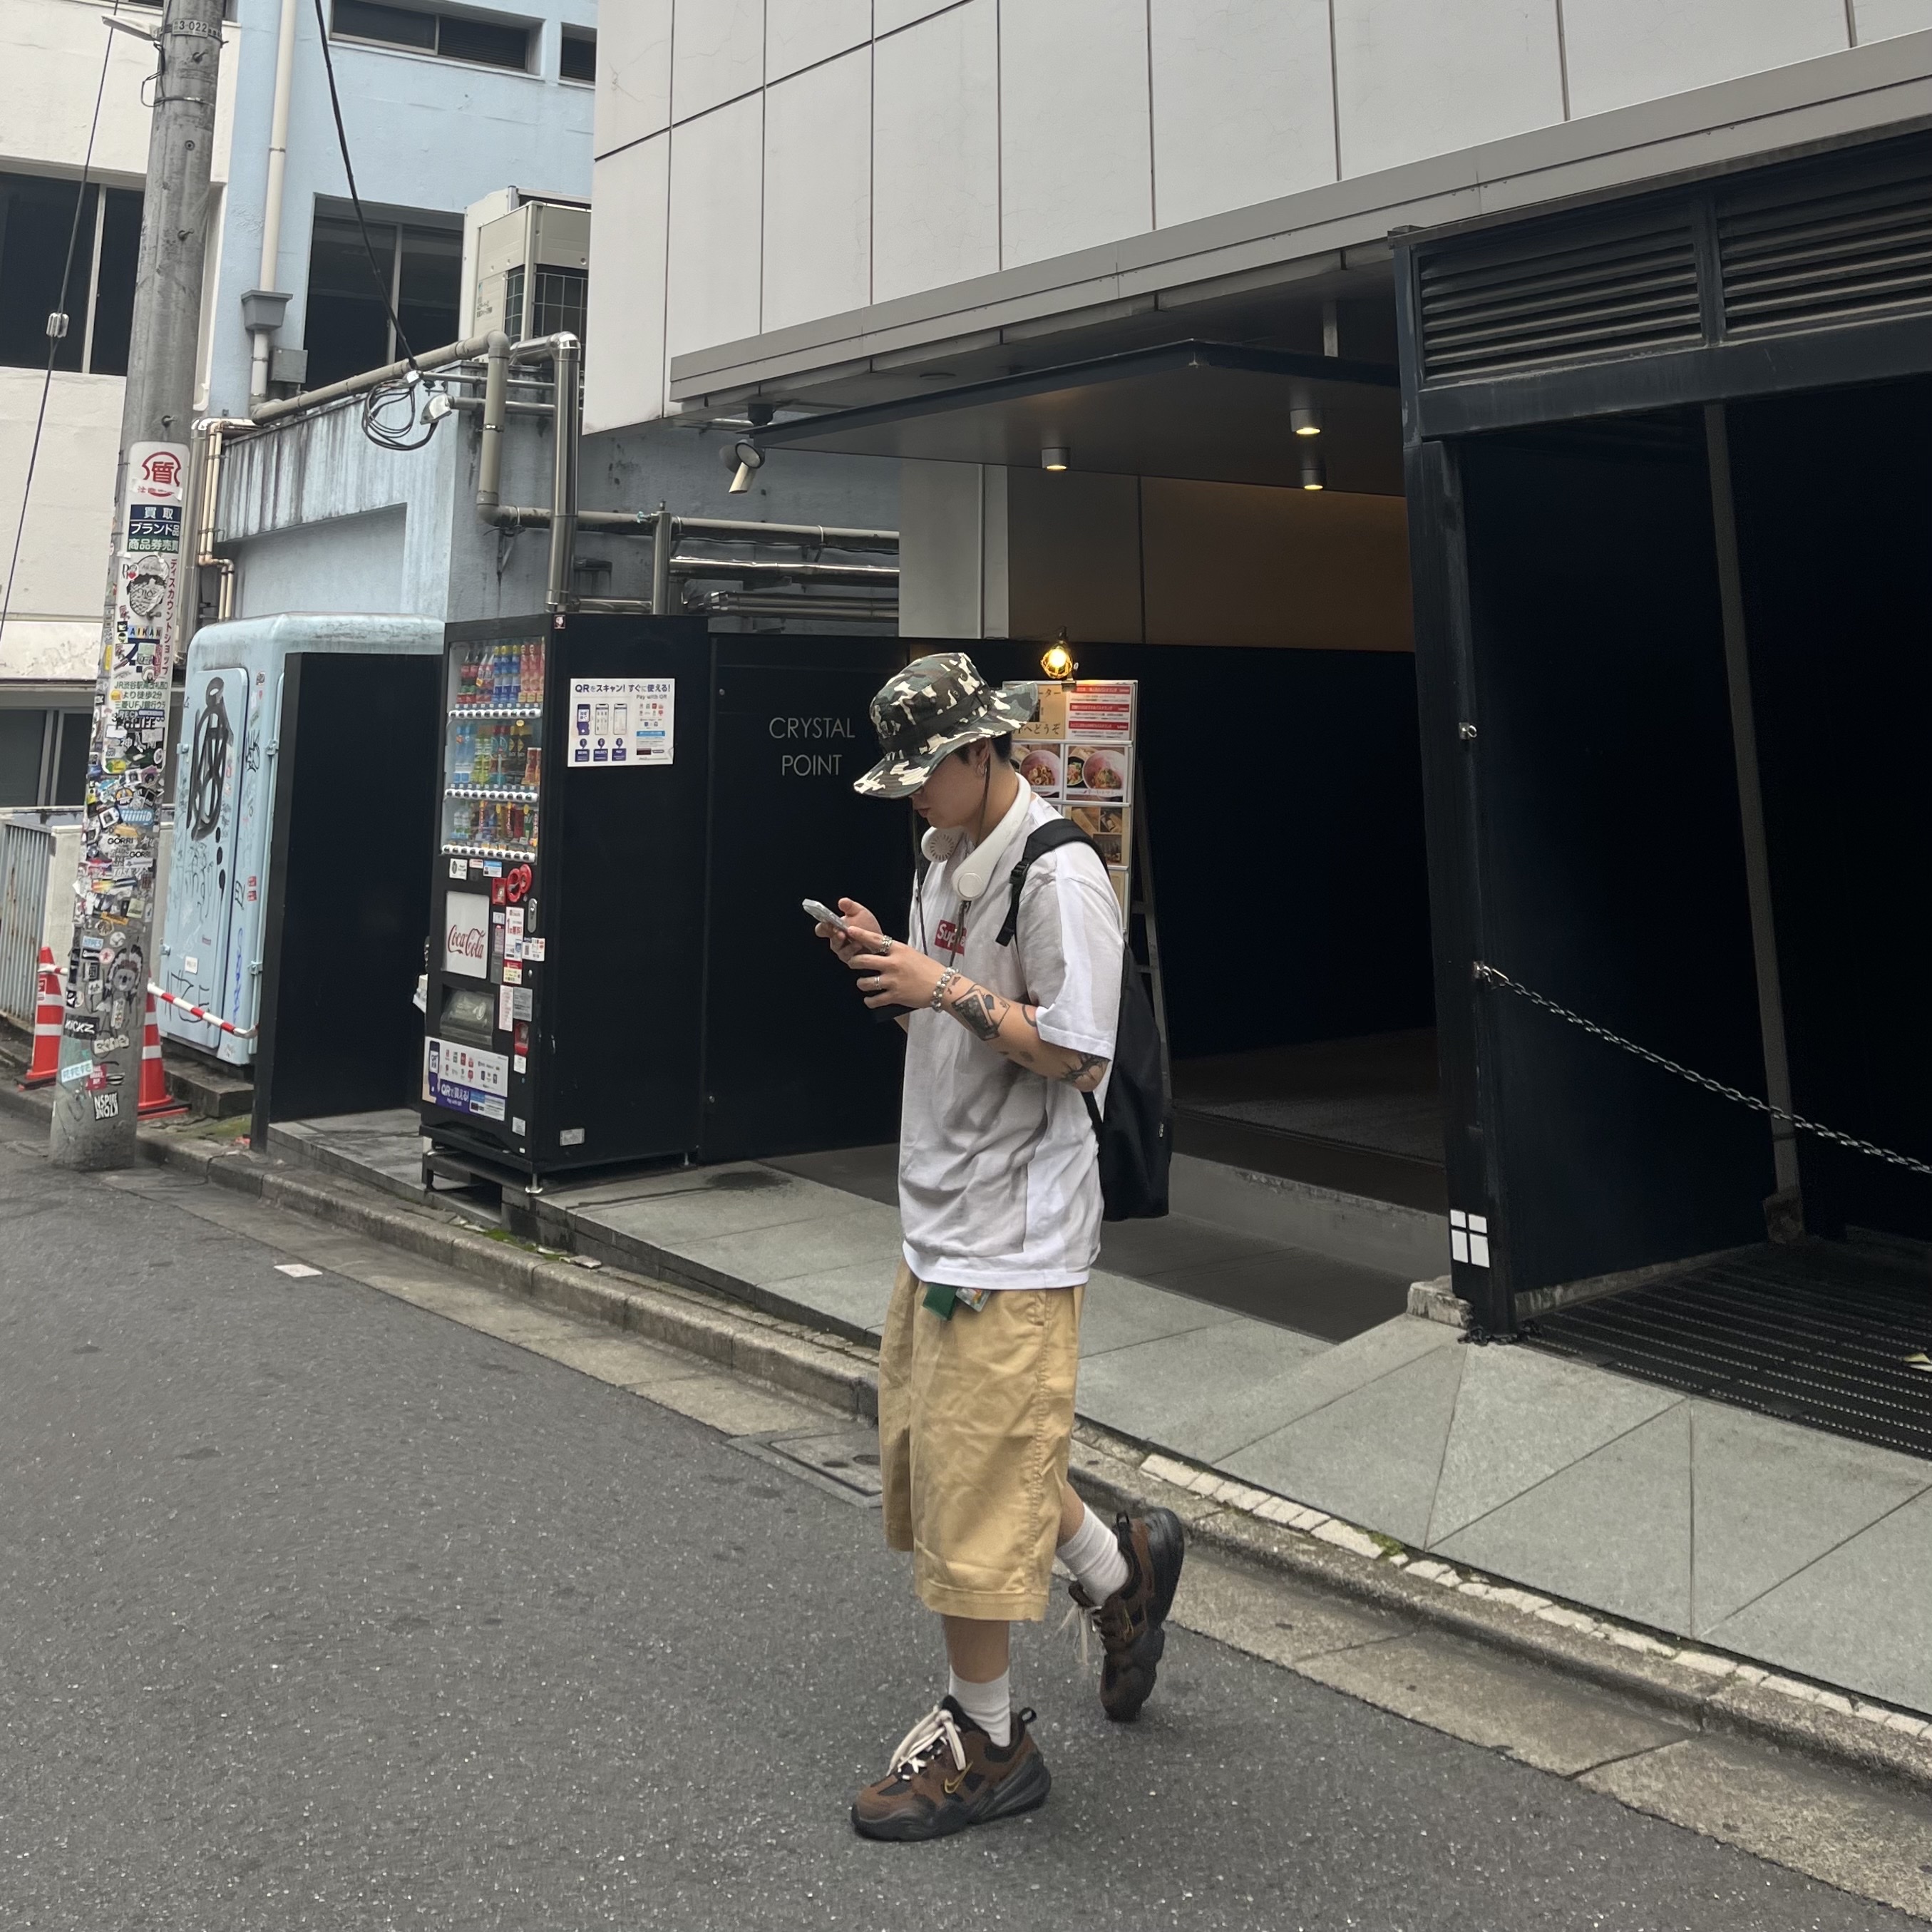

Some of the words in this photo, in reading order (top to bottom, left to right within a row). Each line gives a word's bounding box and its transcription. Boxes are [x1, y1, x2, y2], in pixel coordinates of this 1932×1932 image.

[130, 523, 180, 536] ブランド品
[161, 558, 178, 675] ディスカウントショップ
[769, 717, 855, 739] CRYSTAL
[782, 754, 843, 776] POINT
[448, 925, 485, 959] Coca-Cola
